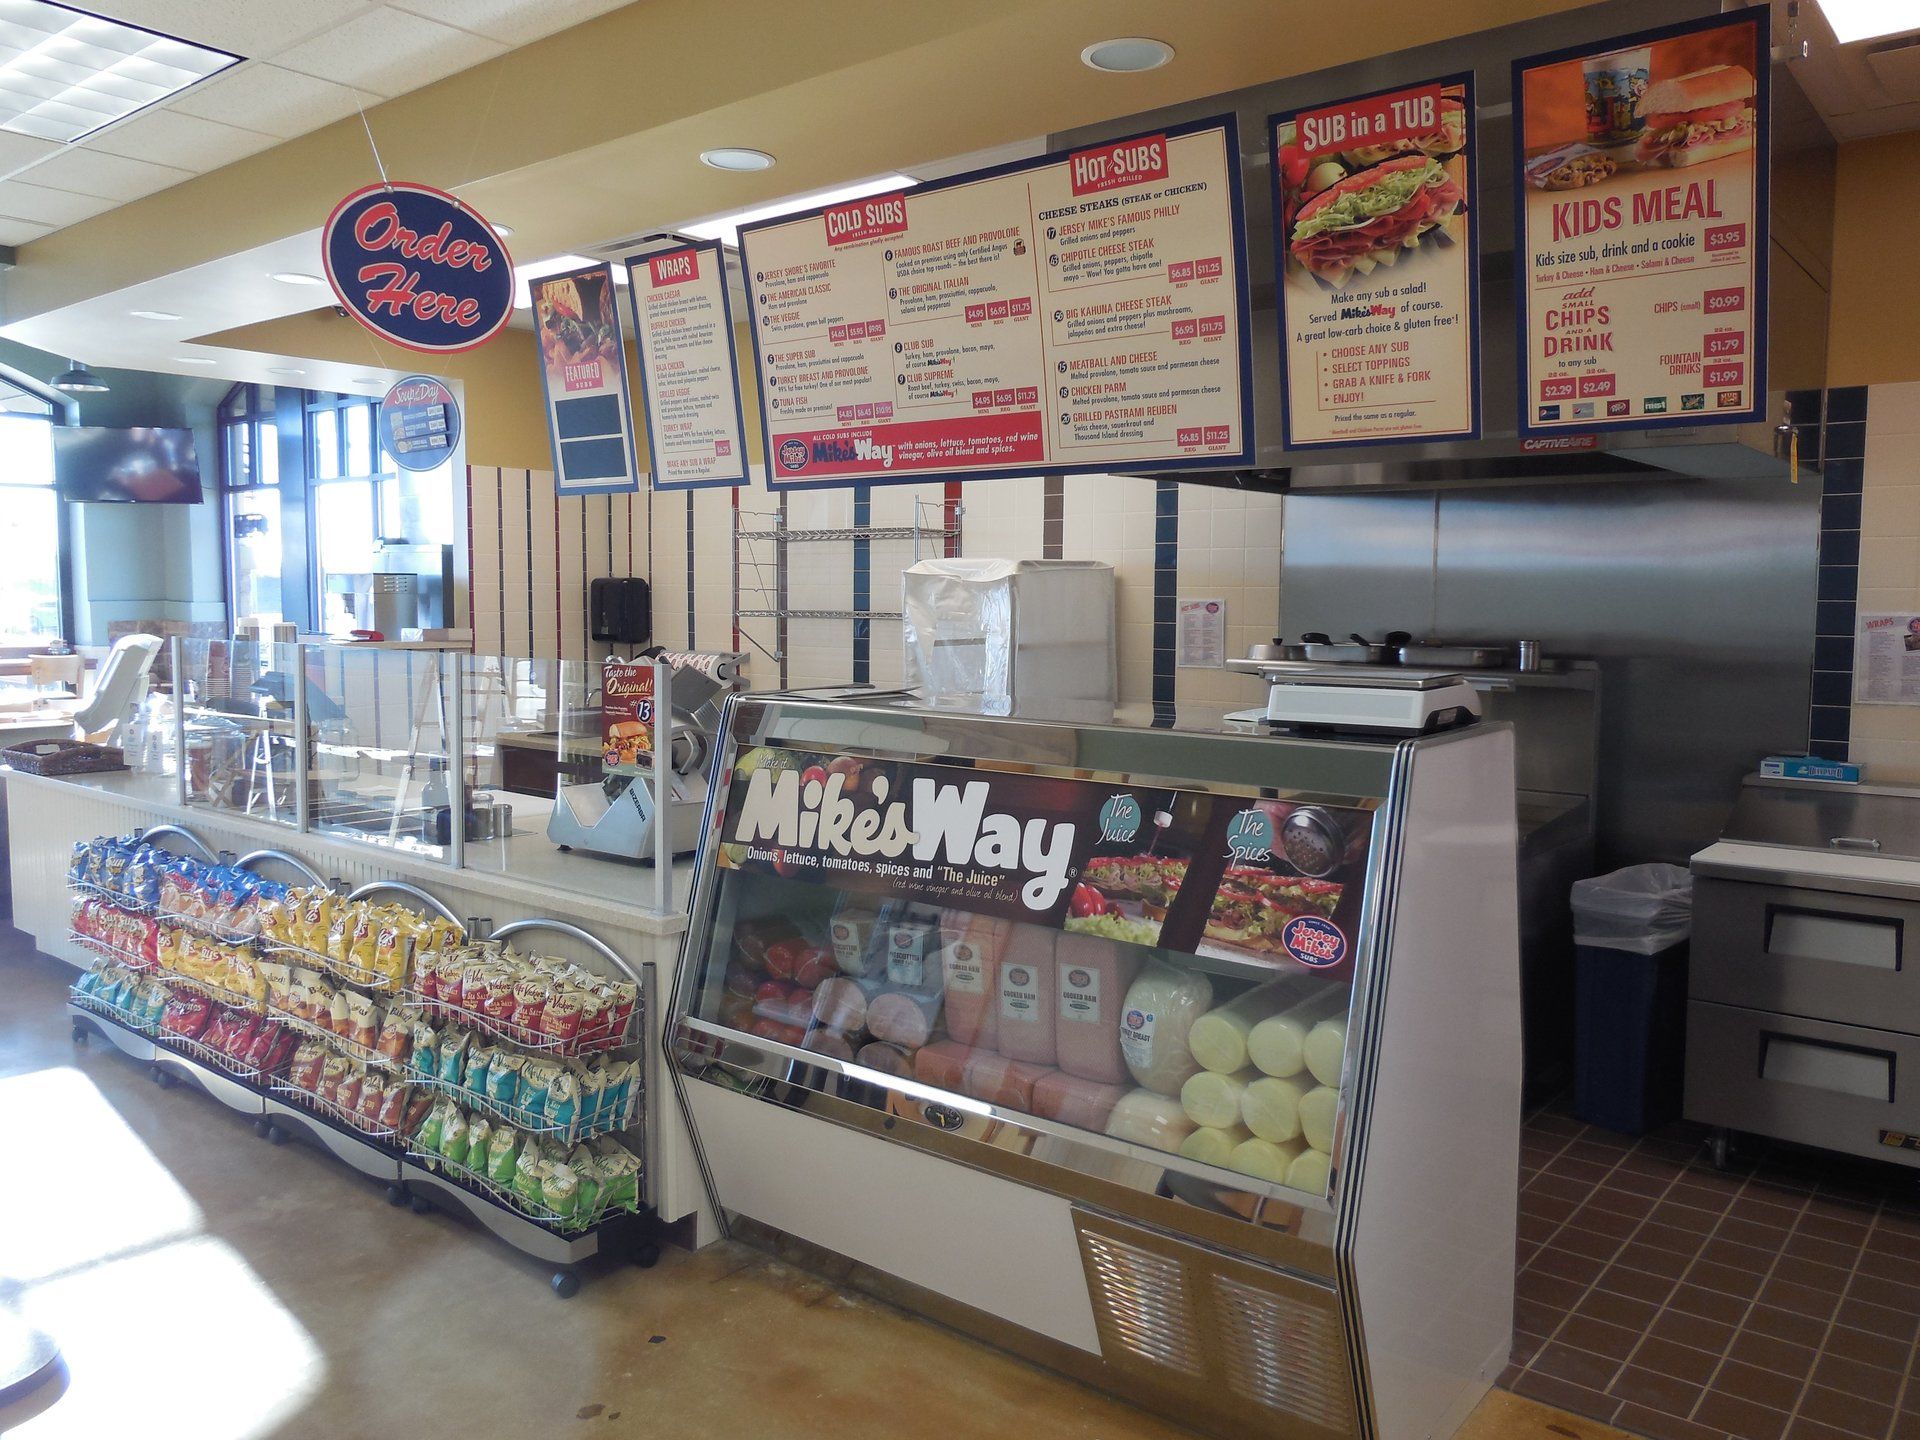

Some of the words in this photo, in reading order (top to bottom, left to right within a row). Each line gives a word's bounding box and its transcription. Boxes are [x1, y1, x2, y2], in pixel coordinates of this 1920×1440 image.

[1304, 115, 1345, 151] SUB
[1352, 112, 1368, 136] in
[1375, 113, 1385, 132] a
[1391, 95, 1434, 129] TUB
[1075, 156, 1107, 187] HOT
[1114, 144, 1162, 174] SUBS
[1118, 175, 1142, 183] GRILLED
[1038, 206, 1077, 221] CHEESE
[1080, 198, 1119, 212] STEAKS
[1122, 193, 1152, 206] (STEAK
[1164, 182, 1207, 196] CHICKEN)
[1553, 196, 1622, 242] KIDS
[1632, 179, 1722, 224] MEAL
[828, 209, 861, 237] COLD
[866, 201, 902, 226] SUBS
[1059, 221, 1086, 236] JERSEY
[1088, 216, 1115, 230] MIKE'S
[1118, 210, 1150, 225] FAMOUS
[1154, 205, 1180, 219] PHILLY
[355, 202, 491, 272] Order
[895, 246, 920, 258] FAMOUS
[923, 242, 943, 253] ROAST
[946, 238, 960, 249] BEEF
[963, 235, 977, 246] AND
[979, 227, 1020, 243] PROVOLONE
[1710, 231, 1740, 245] $3.95
[1536, 252, 1554, 267] Kids
[1558, 250, 1575, 263] size
[1579, 246, 1598, 261] sub,
[1602, 240, 1627, 258] drink
[1632, 239, 1649, 253] and
[1653, 243, 1658, 251] a
[1662, 233, 1695, 250] cookie
[657, 256, 691, 280] WRAPS
[764, 270, 783, 280] JERSEY
[785, 265, 808, 277] SHORE'S
[809, 259, 836, 272] FAVORITE
[1171, 268, 1191, 278] $6.85
[1198, 263, 1220, 273] $11.25
[358, 263, 480, 326] Here
[768, 293, 777, 302] THE
[779, 288, 806, 300] AMERICAN
[808, 284, 831, 295] CLASSIC
[899, 287, 910, 296] THE
[912, 282, 941, 294] ORIGINAL
[944, 277, 969, 289] ITALIAN
[1332, 292, 1353, 304] Make
[1357, 292, 1372, 303] any
[1375, 287, 1389, 298] sub
[1400, 283, 1426, 295] salad!
[1562, 287, 1595, 300] add
[989, 307, 1006, 315] $6.95
[1011, 303, 1030, 312] $11.75
[1066, 309, 1078, 319] BIG
[1081, 304, 1112, 317] KAHUNA
[1116, 299, 1143, 312] CHEESE
[1146, 295, 1172, 308] STEAK
[1562, 300, 1594, 309] SMALL
[1654, 302, 1677, 314] CHIPS
[1681, 301, 1700, 313] (small)
[1710, 296, 1740, 308] $0.99
[1309, 311, 1336, 324] Served
[1401, 301, 1409, 313] of
[1412, 301, 1443, 311] course.
[1546, 306, 1611, 330] CHIPS
[904, 341, 919, 350] CLUB
[921, 339, 934, 348] SUB
[1332, 346, 1365, 358] CHOOSE
[1369, 344, 1388, 354] ANY
[1391, 342, 1409, 352] SUB
[1544, 332, 1614, 358] DRINK
[1711, 339, 1739, 351] $1.79
[1070, 357, 1108, 370] MEATBALL
[1110, 355, 1126, 365] AND
[1129, 352, 1158, 363] CHEESE
[1333, 362, 1362, 374] SELECT
[1365, 357, 1410, 370] TOPPINGS
[1568, 359, 1581, 367] any
[1584, 356, 1597, 365] sub
[1660, 352, 1701, 365] FOUNTAIN
[565, 362, 600, 382] FEATURED
[777, 374, 798, 385] TURKEY
[800, 372, 820, 382] BREAST
[822, 370, 833, 379] AND
[835, 366, 868, 378] PROVOLONE
[1670, 363, 1701, 375] DRINKS
[1710, 371, 1738, 382] $1.99
[1072, 384, 1101, 396] CHICKEN
[1105, 382, 1127, 393] PARM
[1333, 378, 1356, 388] GRAB
[1360, 377, 1366, 386] A
[1370, 374, 1394, 385] KNIFE
[1398, 374, 1403, 383] &
[1407, 371, 1430, 382] FORK
[1546, 385, 1572, 396] $2.29
[1583, 381, 1610, 393] $2.49
[1334, 392, 1364, 403] ENJOY!
[1073, 411, 1101, 421] GRILLED
[1105, 407, 1144, 419] PASTRAMI
[1147, 404, 1177, 416] REUBEN
[899, 442, 913, 450] with
[915, 440, 938, 450] onions,
[941, 438, 965, 448] lettuce,
[969, 435, 1003, 447] tomatoes,
[1006, 434, 1017, 443] red
[1021, 433, 1038, 442] wine
[604, 665, 623, 678] Taste
[625, 666, 637, 678] the
[606, 677, 653, 698] Original!
[639, 701, 650, 720] 13
[1111, 793, 1132, 819] The
[1095, 818, 1136, 846] Juice
[1238, 809, 1264, 837] The
[1222, 836, 1272, 870] Spices
[747, 846, 779, 864] Onions,
[783, 849, 819, 869] lettuce,
[822, 855, 873, 874] tomatoes,
[876, 861, 910, 878] spices
[913, 865, 932, 879] and
[937, 865, 963, 883] "The
[966, 869, 1005, 887] Juice"
[1291, 921, 1340, 950] Jersey
[1290, 934, 1335, 959] Mike's
[1300, 953, 1318, 963] SUBS
